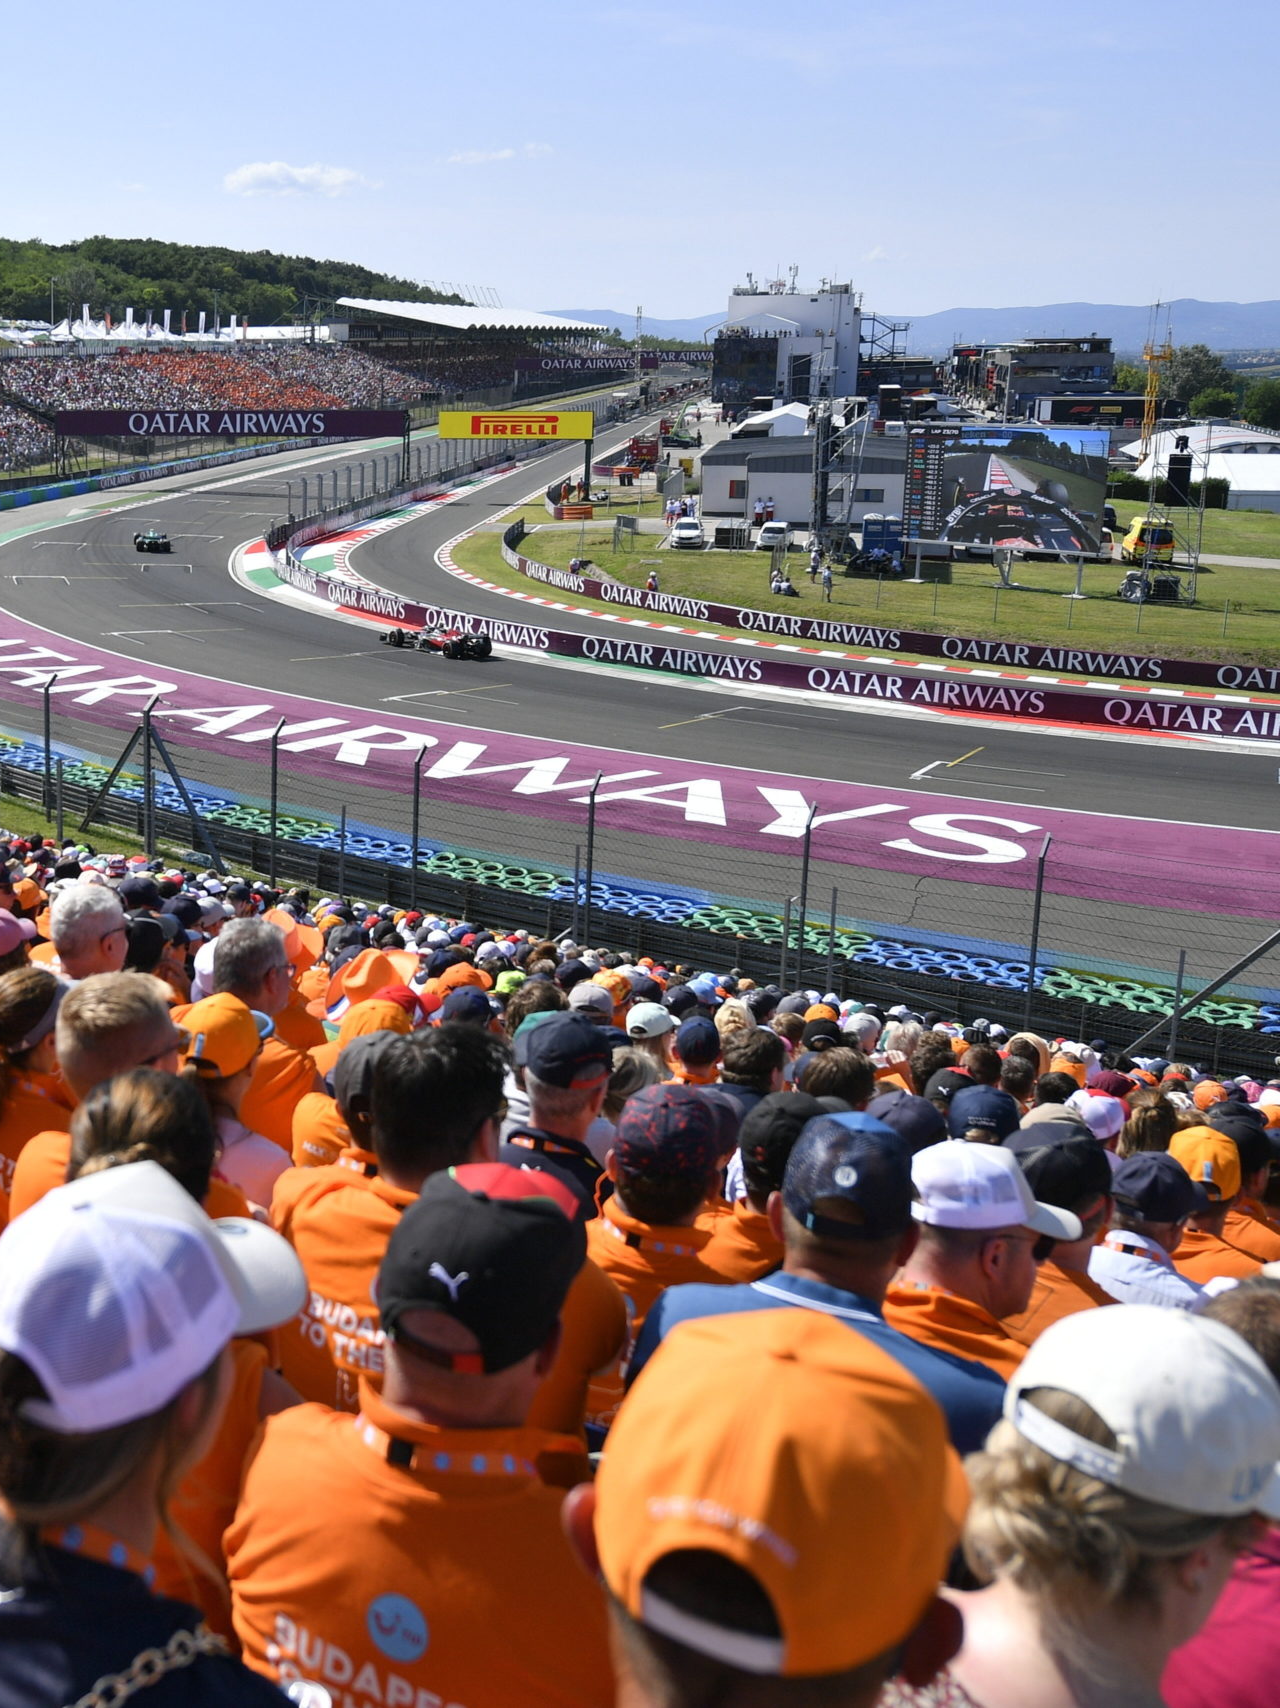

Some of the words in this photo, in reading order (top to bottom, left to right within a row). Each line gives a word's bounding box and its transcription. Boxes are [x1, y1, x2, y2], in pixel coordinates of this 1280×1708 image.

[541, 358, 581, 370] QATAR
[585, 358, 635, 370] AIRWAYS
[128, 413, 211, 435] QATAR
[218, 413, 325, 434] AIRWAYS
[471, 415, 559, 435] PIRELLI
[526, 560, 548, 582] QATAR
[548, 570, 585, 593] AIRWAYS
[328, 584, 358, 607] QATAR
[359, 595, 406, 619] AIRWAYS
[600, 583, 642, 607] QATAR
[645, 590, 709, 619] AIRWAYS
[426, 609, 475, 634] QATAR
[478, 620, 550, 649] AIRWAYS
[738, 610, 802, 636] QATAR
[809, 621, 901, 650] AIRWAYS
[582, 637, 654, 666] QATAR
[659, 650, 762, 680] AIRWAYS
[942, 637, 1030, 666] QATAR
[1037, 648, 1163, 679] AIRWAYS
[808, 667, 903, 699] QATAR
[911, 680, 1045, 714] AIRWAYS
[1217, 665, 1280, 689] QAT
[1104, 699, 1223, 732] QATAR
[127, 704, 1044, 864] AIRWAYS
